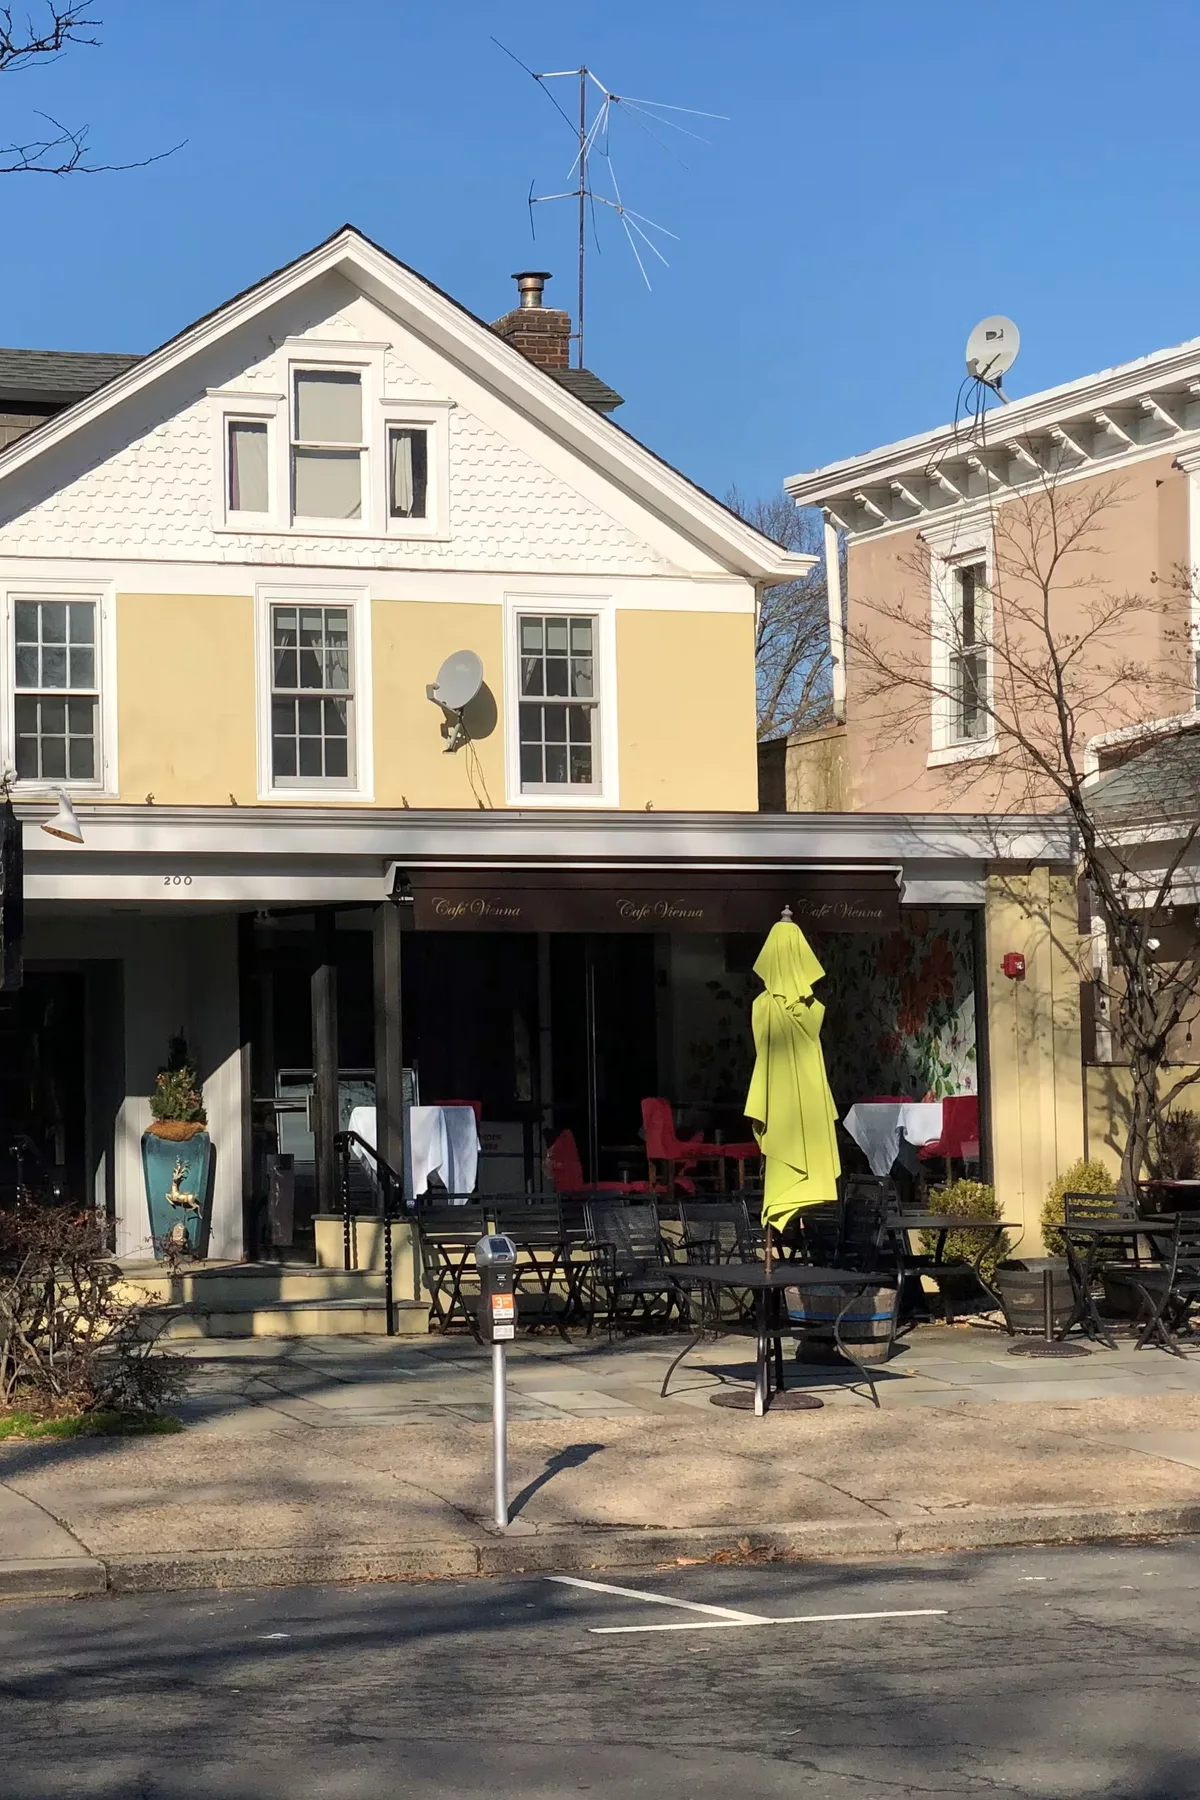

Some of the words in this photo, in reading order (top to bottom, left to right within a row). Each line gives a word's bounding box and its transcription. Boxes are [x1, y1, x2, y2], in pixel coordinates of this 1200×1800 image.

[164, 875, 193, 886] 200
[432, 897, 468, 921] Café
[470, 897, 521, 917] Vienna
[616, 899, 651, 921] Café
[654, 899, 704, 918] Vienna
[798, 899, 833, 919] Café
[834, 899, 883, 918] Vienna
[495, 1297, 503, 1309] 3
